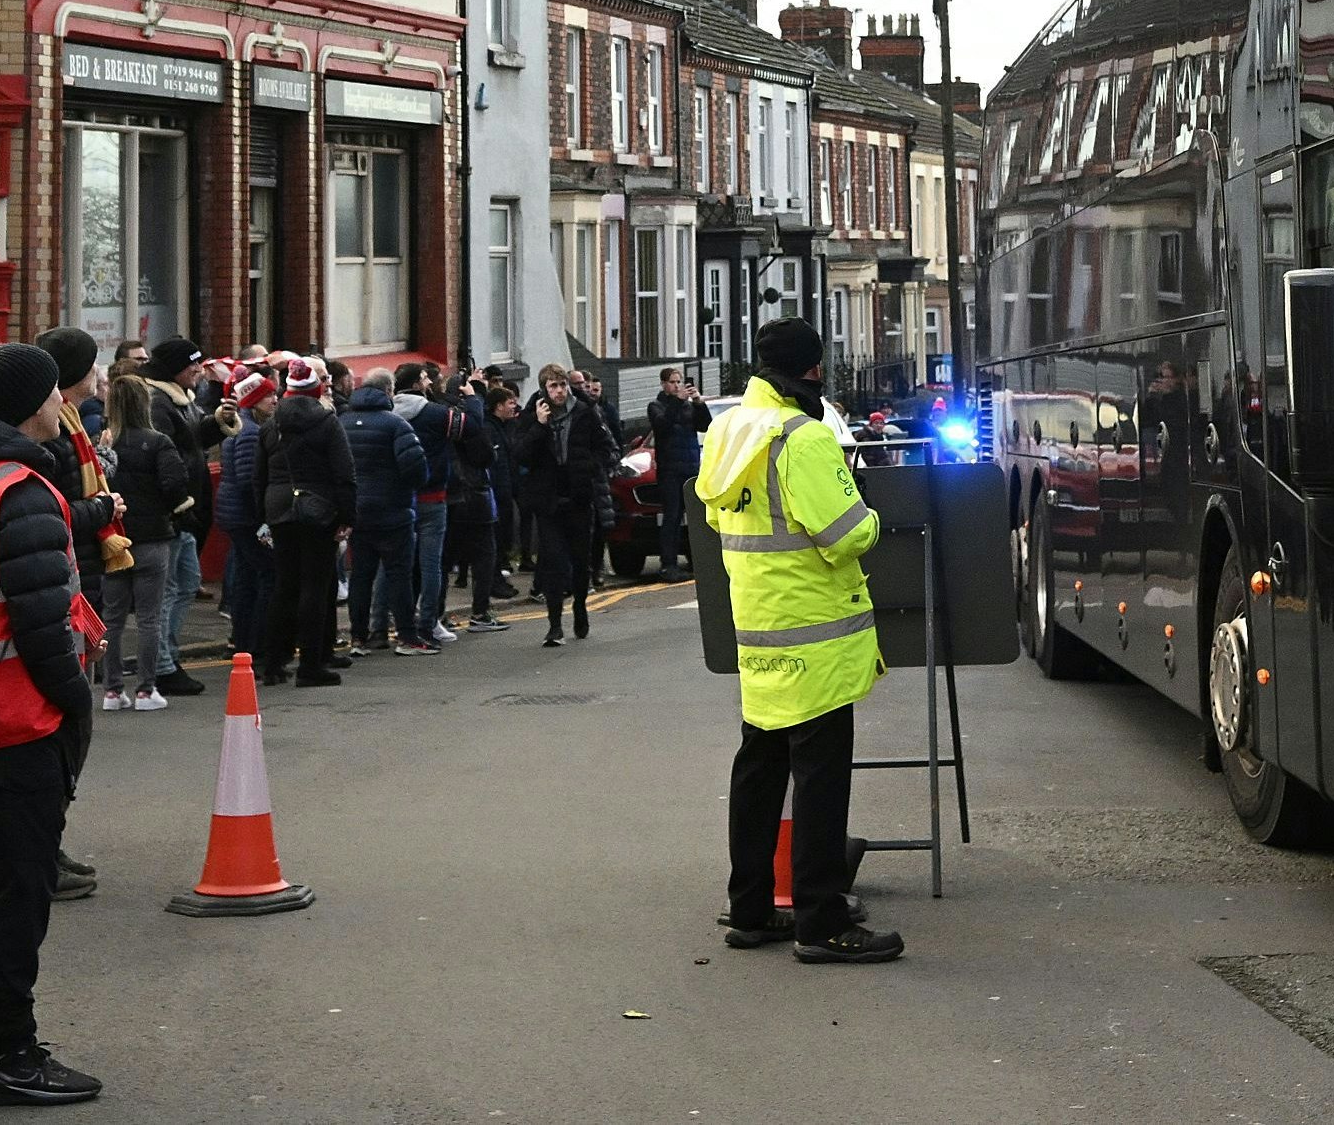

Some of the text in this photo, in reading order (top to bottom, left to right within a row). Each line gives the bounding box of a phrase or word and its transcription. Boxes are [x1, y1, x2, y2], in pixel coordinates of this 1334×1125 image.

[69, 54, 158, 87] BED & BREAKFAST
[163, 78, 182, 92] 0151
[200, 83, 218, 97] 9769
